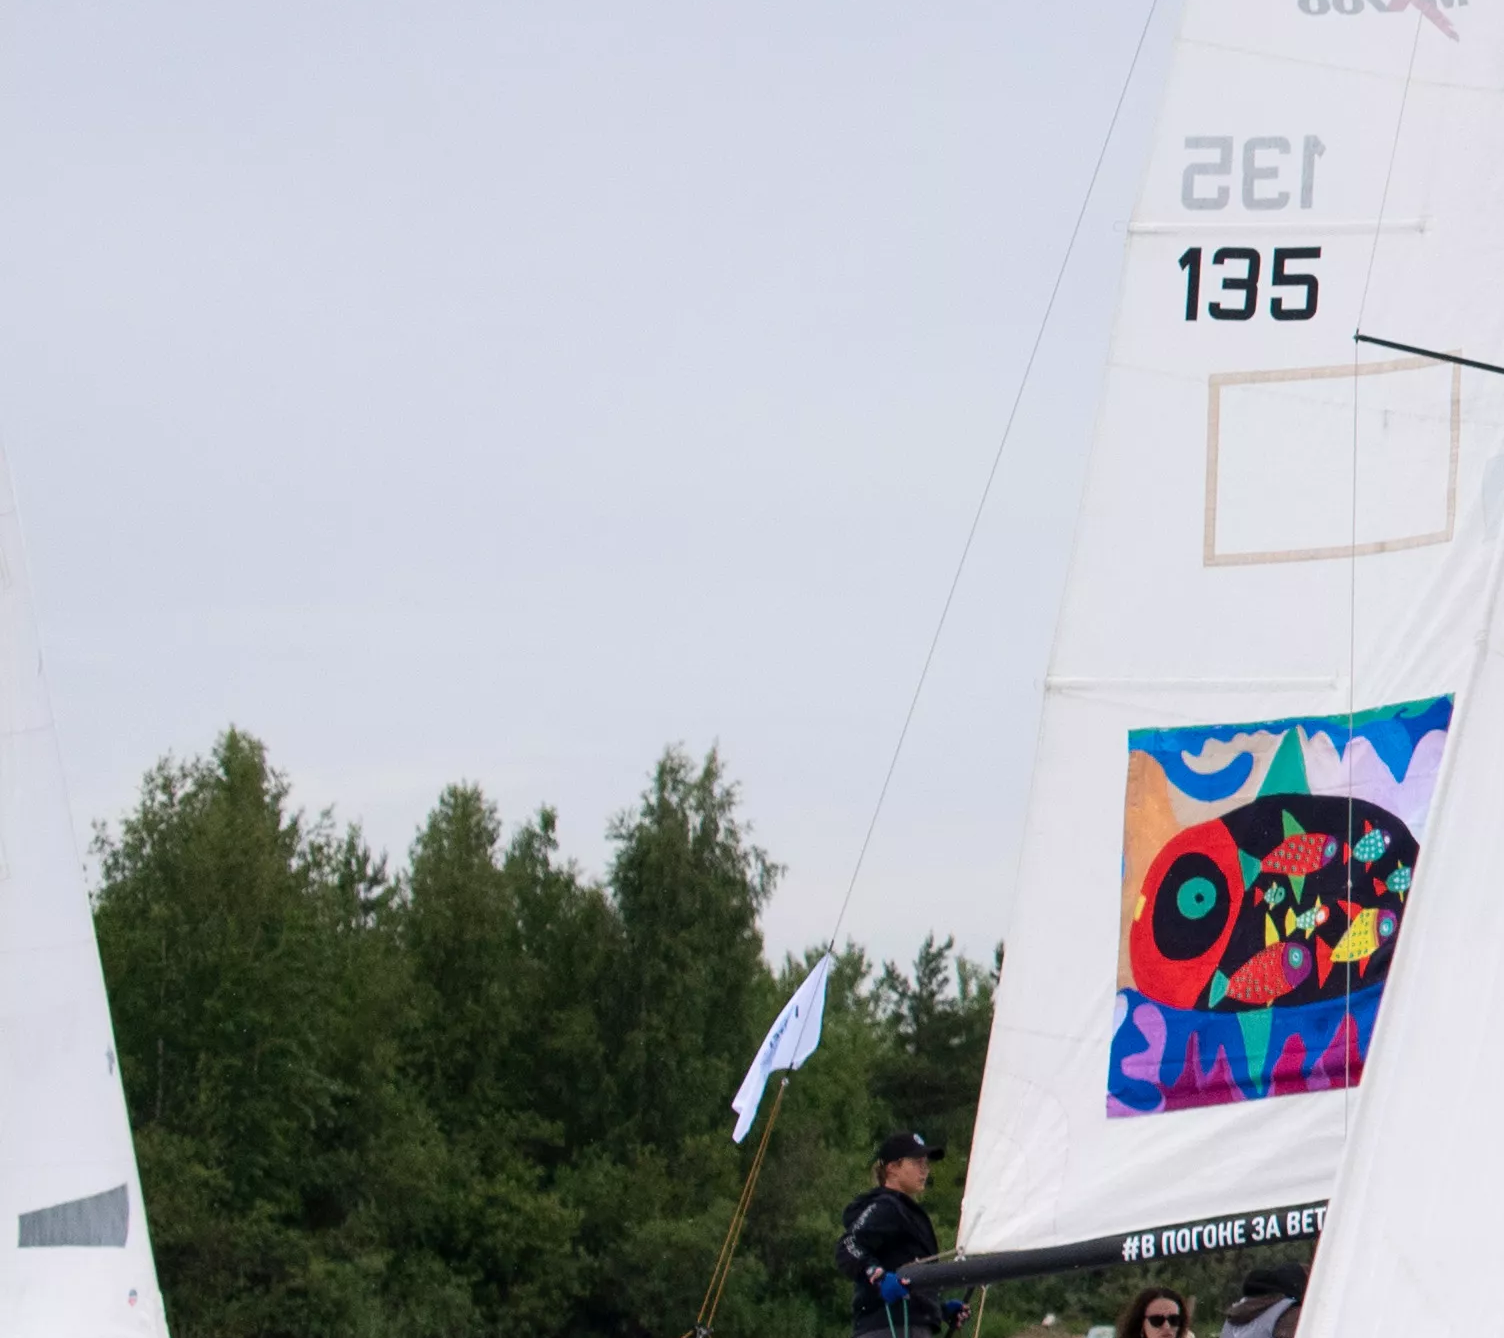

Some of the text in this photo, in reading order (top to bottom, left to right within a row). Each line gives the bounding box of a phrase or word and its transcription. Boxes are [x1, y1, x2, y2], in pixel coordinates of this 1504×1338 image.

[1178, 247, 1321, 321] 135
[1161, 1219, 1246, 1256] ПОГОНЕ
[1251, 1214, 1281, 1241] ЗА
